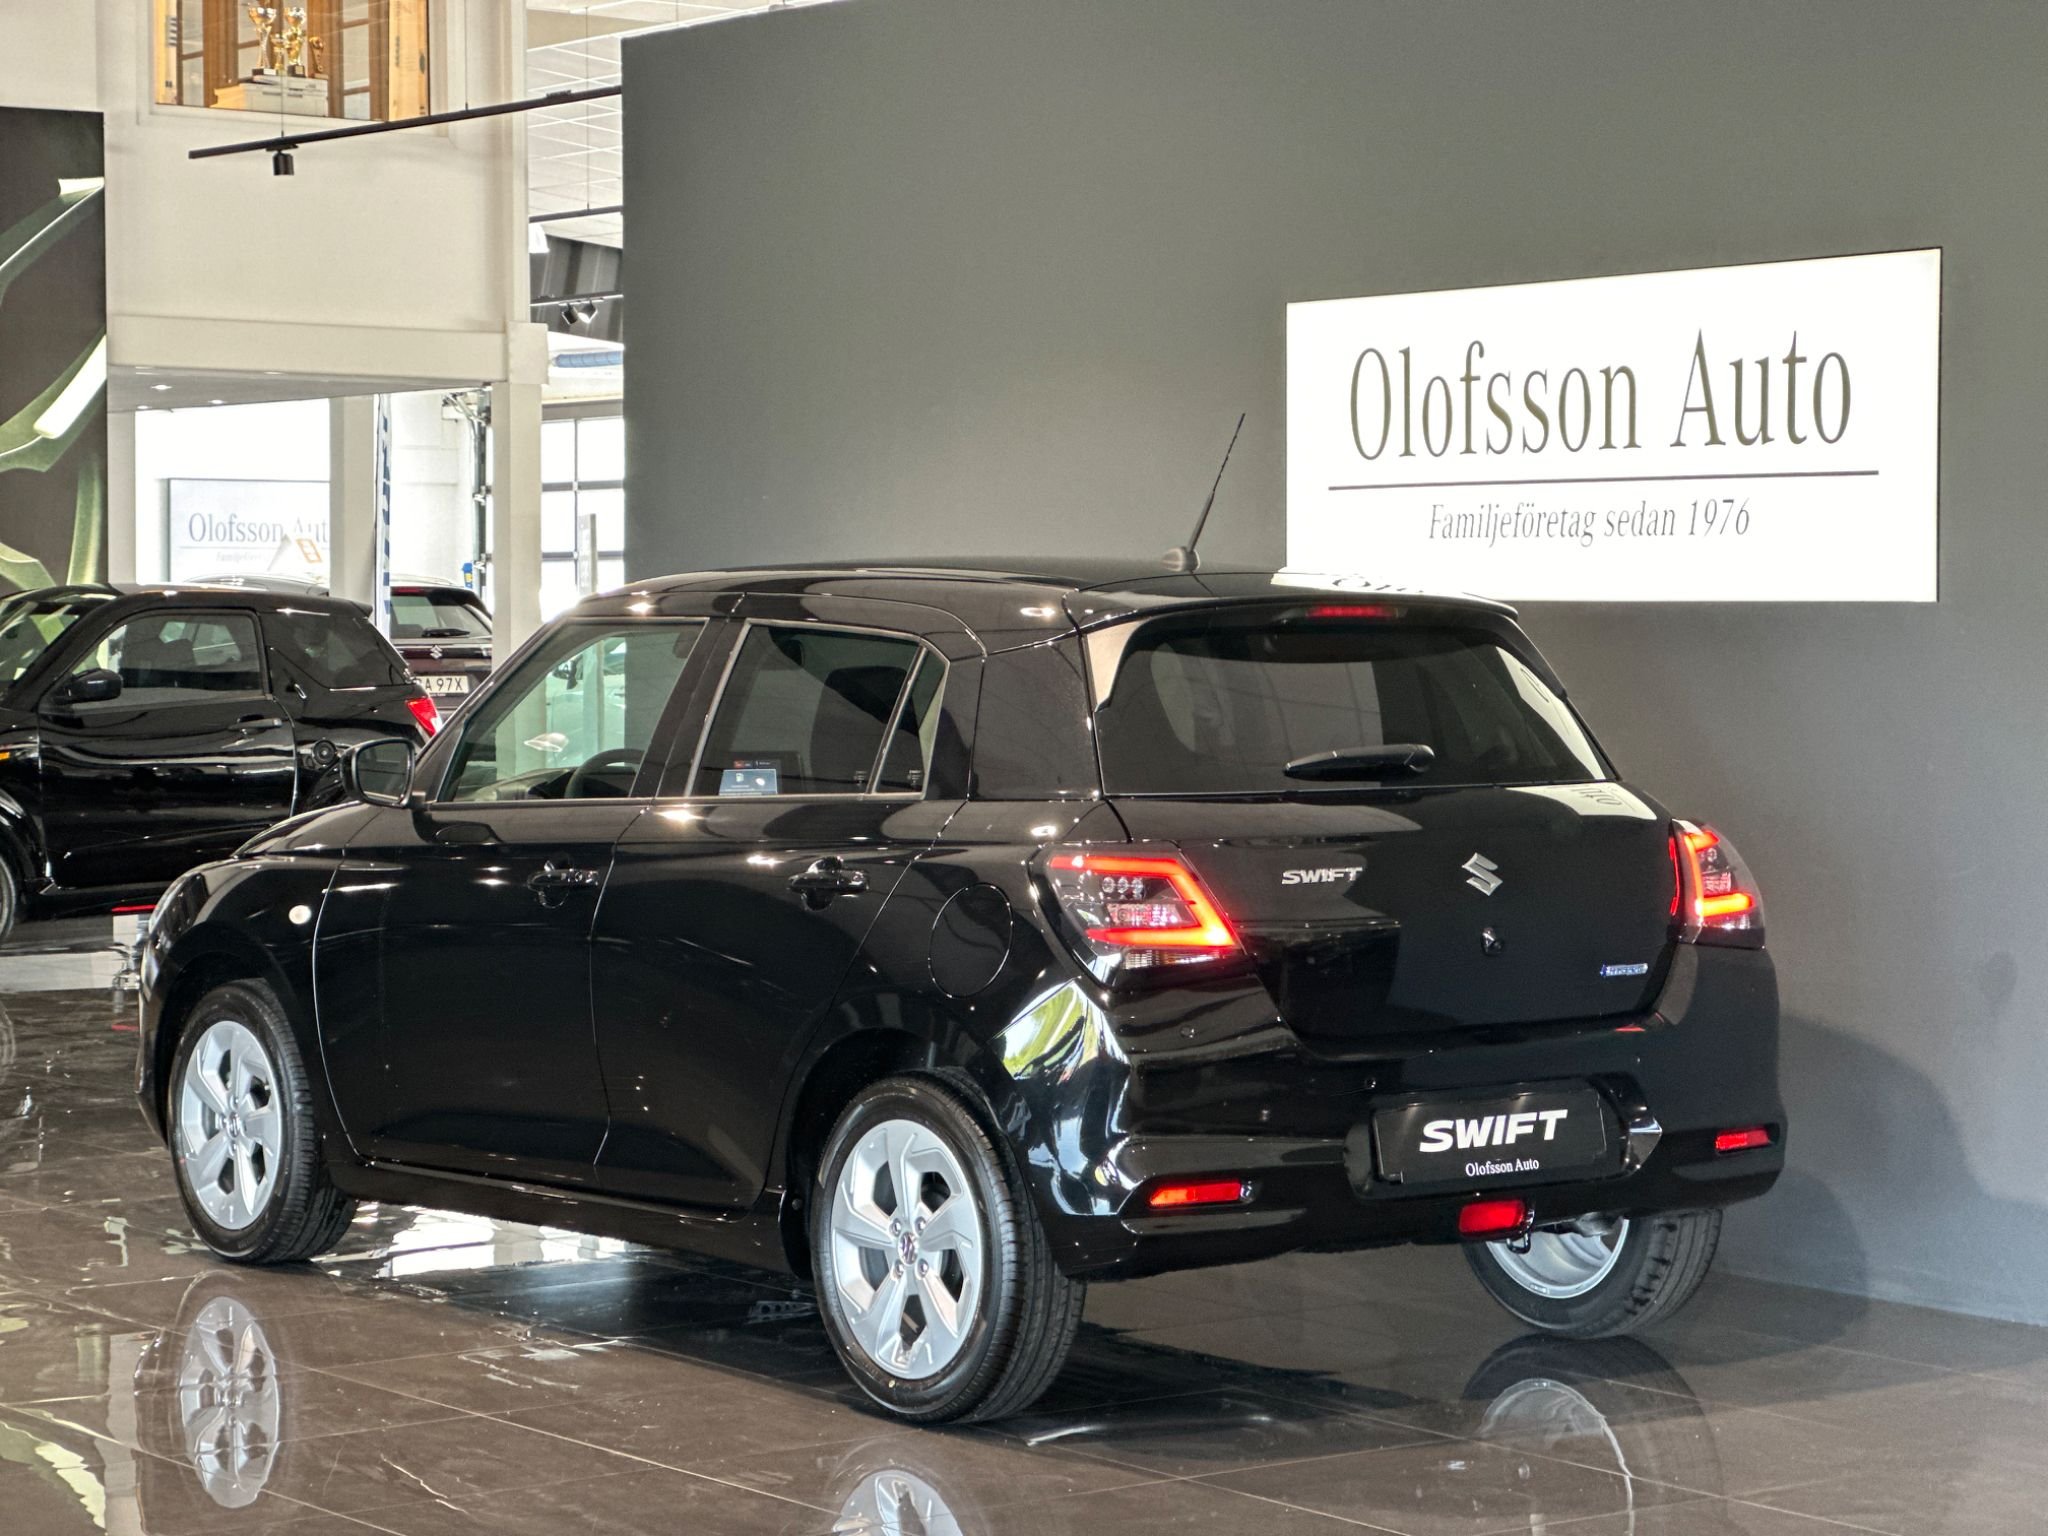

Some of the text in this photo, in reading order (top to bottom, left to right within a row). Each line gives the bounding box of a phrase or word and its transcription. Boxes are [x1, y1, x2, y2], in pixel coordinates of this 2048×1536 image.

[1350, 328, 1853, 461] Olofsson Auto
[188, 512, 285, 543] Olofsson
[1429, 498, 1751, 549] Familjeföretag sedan 1976
[436, 676, 463, 692] 97X
[1281, 866, 1363, 885] SWIFT
[1419, 1108, 1569, 1153] SWIFT
[1465, 1157, 1540, 1177] Olofsson Auto
